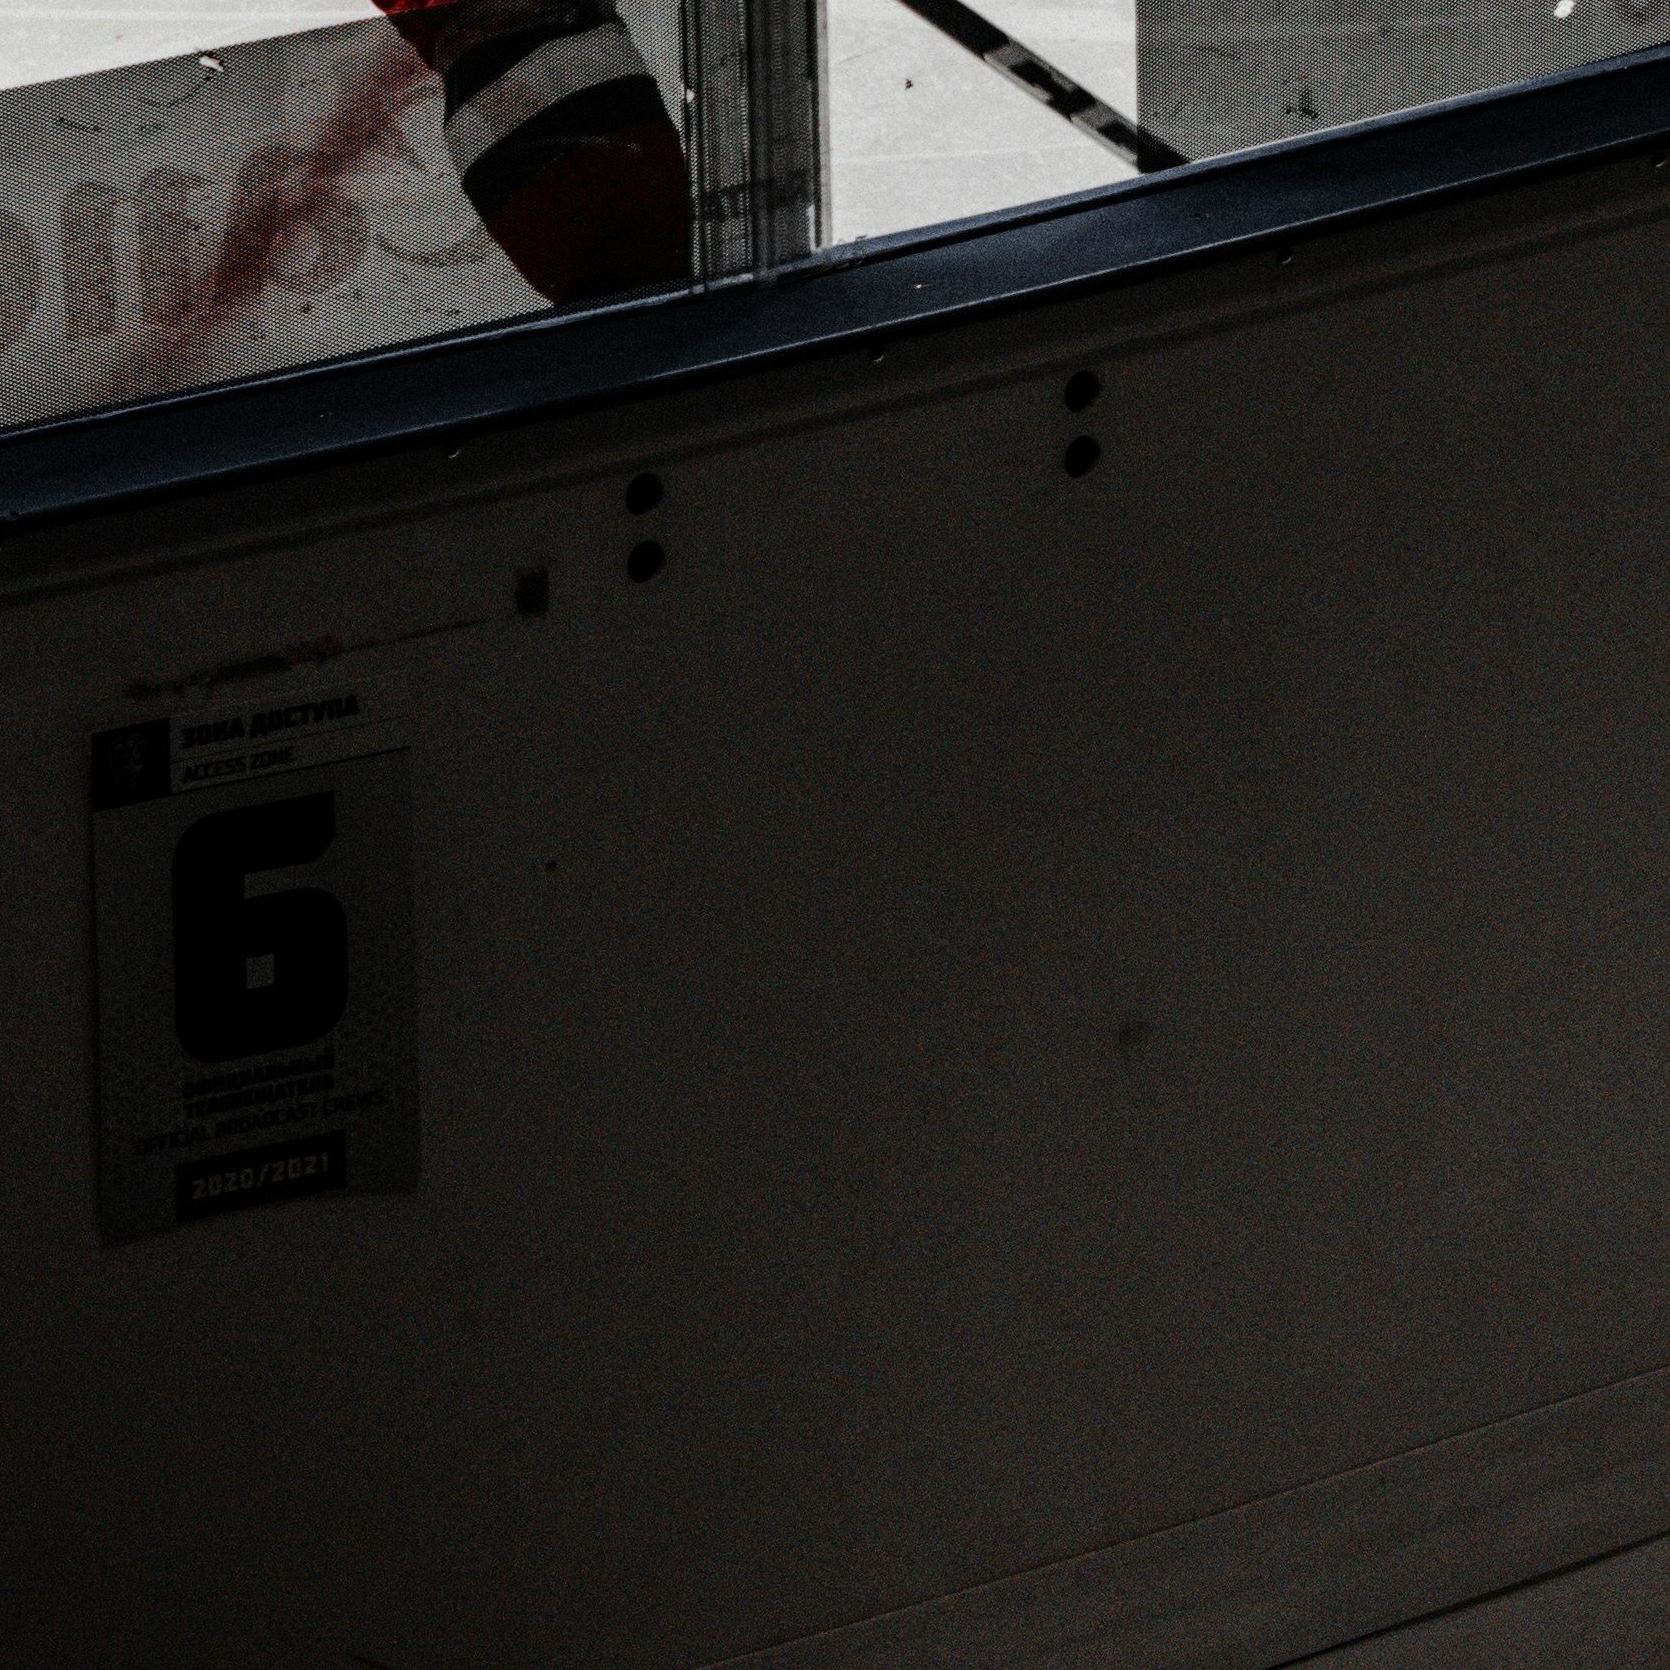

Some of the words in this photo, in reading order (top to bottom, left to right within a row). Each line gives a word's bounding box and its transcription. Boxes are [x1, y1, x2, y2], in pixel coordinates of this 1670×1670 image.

[180, 717, 246, 749] ЗОНА
[249, 694, 361, 739] ДОСТУПА
[181, 758, 247, 784] ACCESS
[249, 746, 296, 771] ZONE
[172, 790, 350, 1064] 6
[134, 1126, 211, 1157] OFFICIAL
[214, 1101, 319, 1139] BROADCAST
[322, 1088, 386, 1117] CREWS
[191, 1152, 330, 1201] 2020/2021
